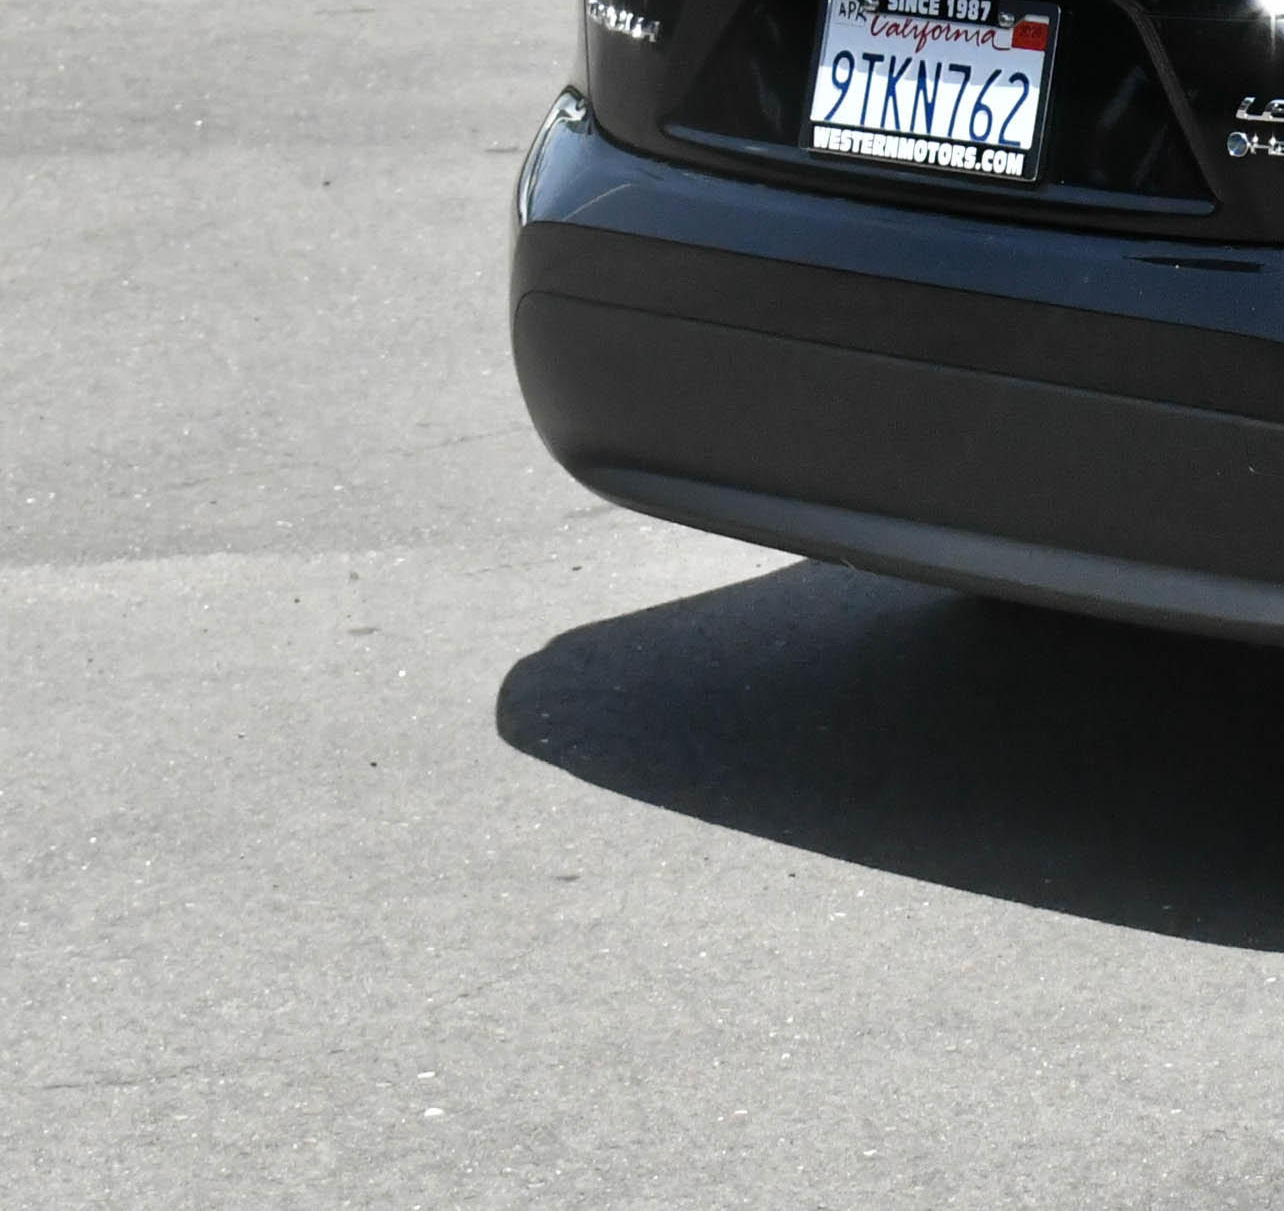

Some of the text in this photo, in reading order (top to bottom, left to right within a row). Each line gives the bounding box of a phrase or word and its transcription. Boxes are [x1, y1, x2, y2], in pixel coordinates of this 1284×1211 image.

[870, 14, 1011, 53] California
[824, 49, 1030, 147] 9TKN762
[813, 125, 1025, 176] WESTERNMOTORS.COM
